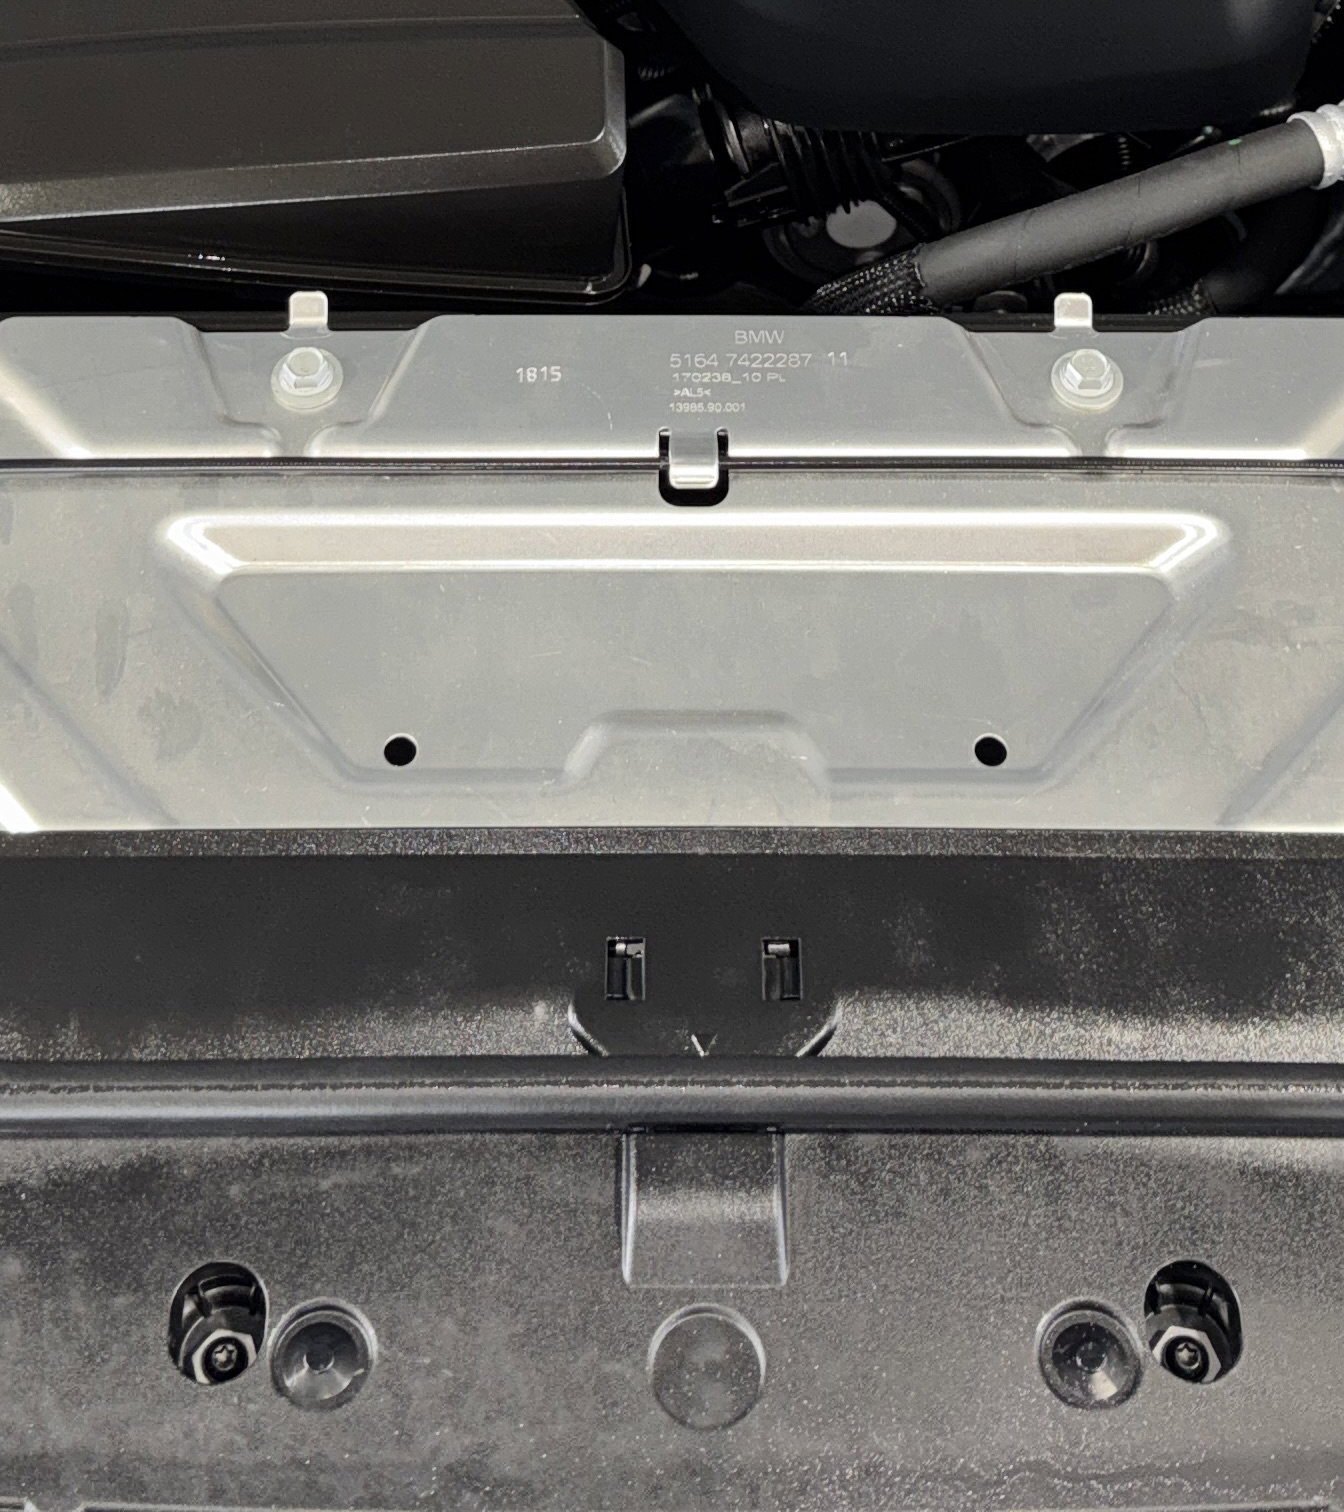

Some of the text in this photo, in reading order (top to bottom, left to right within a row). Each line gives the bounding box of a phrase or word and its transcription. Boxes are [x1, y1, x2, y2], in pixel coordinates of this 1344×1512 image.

[735, 330, 784, 345] BMW
[670, 351, 849, 368] 5164 7422287 11
[516, 366, 562, 383] 1815
